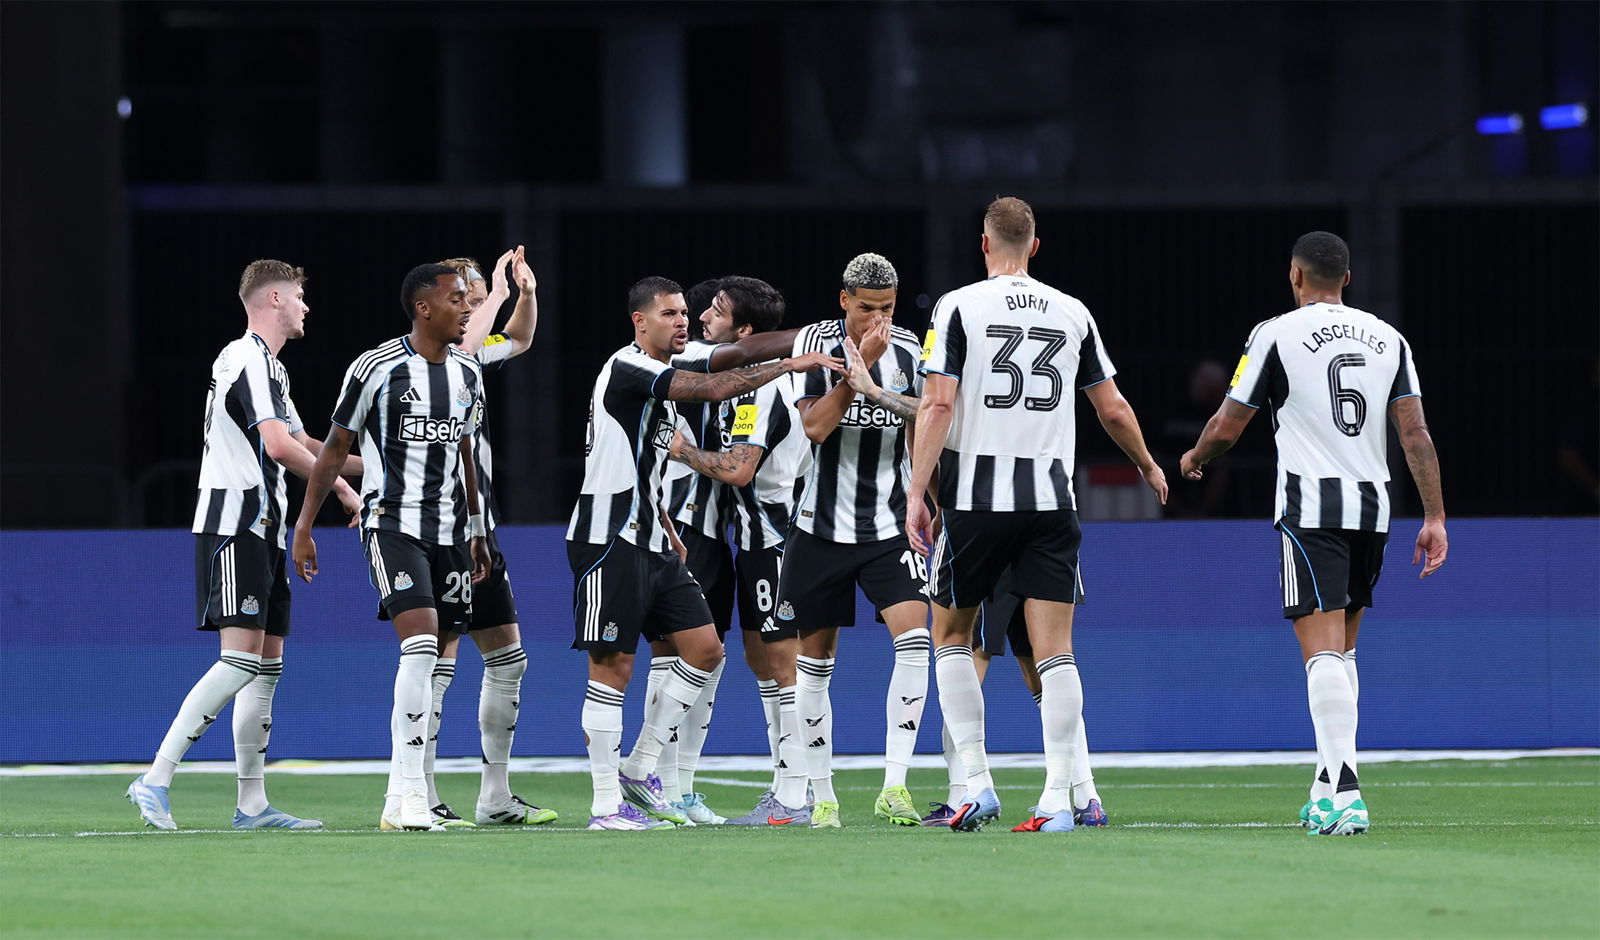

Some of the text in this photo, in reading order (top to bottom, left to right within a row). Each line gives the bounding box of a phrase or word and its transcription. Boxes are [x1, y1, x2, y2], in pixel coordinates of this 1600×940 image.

[1005, 293, 1049, 314] BURN
[1302, 324, 1387, 355] LASCELLES
[984, 324, 1067, 412] 33
[1327, 353, 1367, 438] 6
[899, 550, 929, 583] 18
[441, 570, 472, 604] 28
[756, 578, 773, 612] 8
